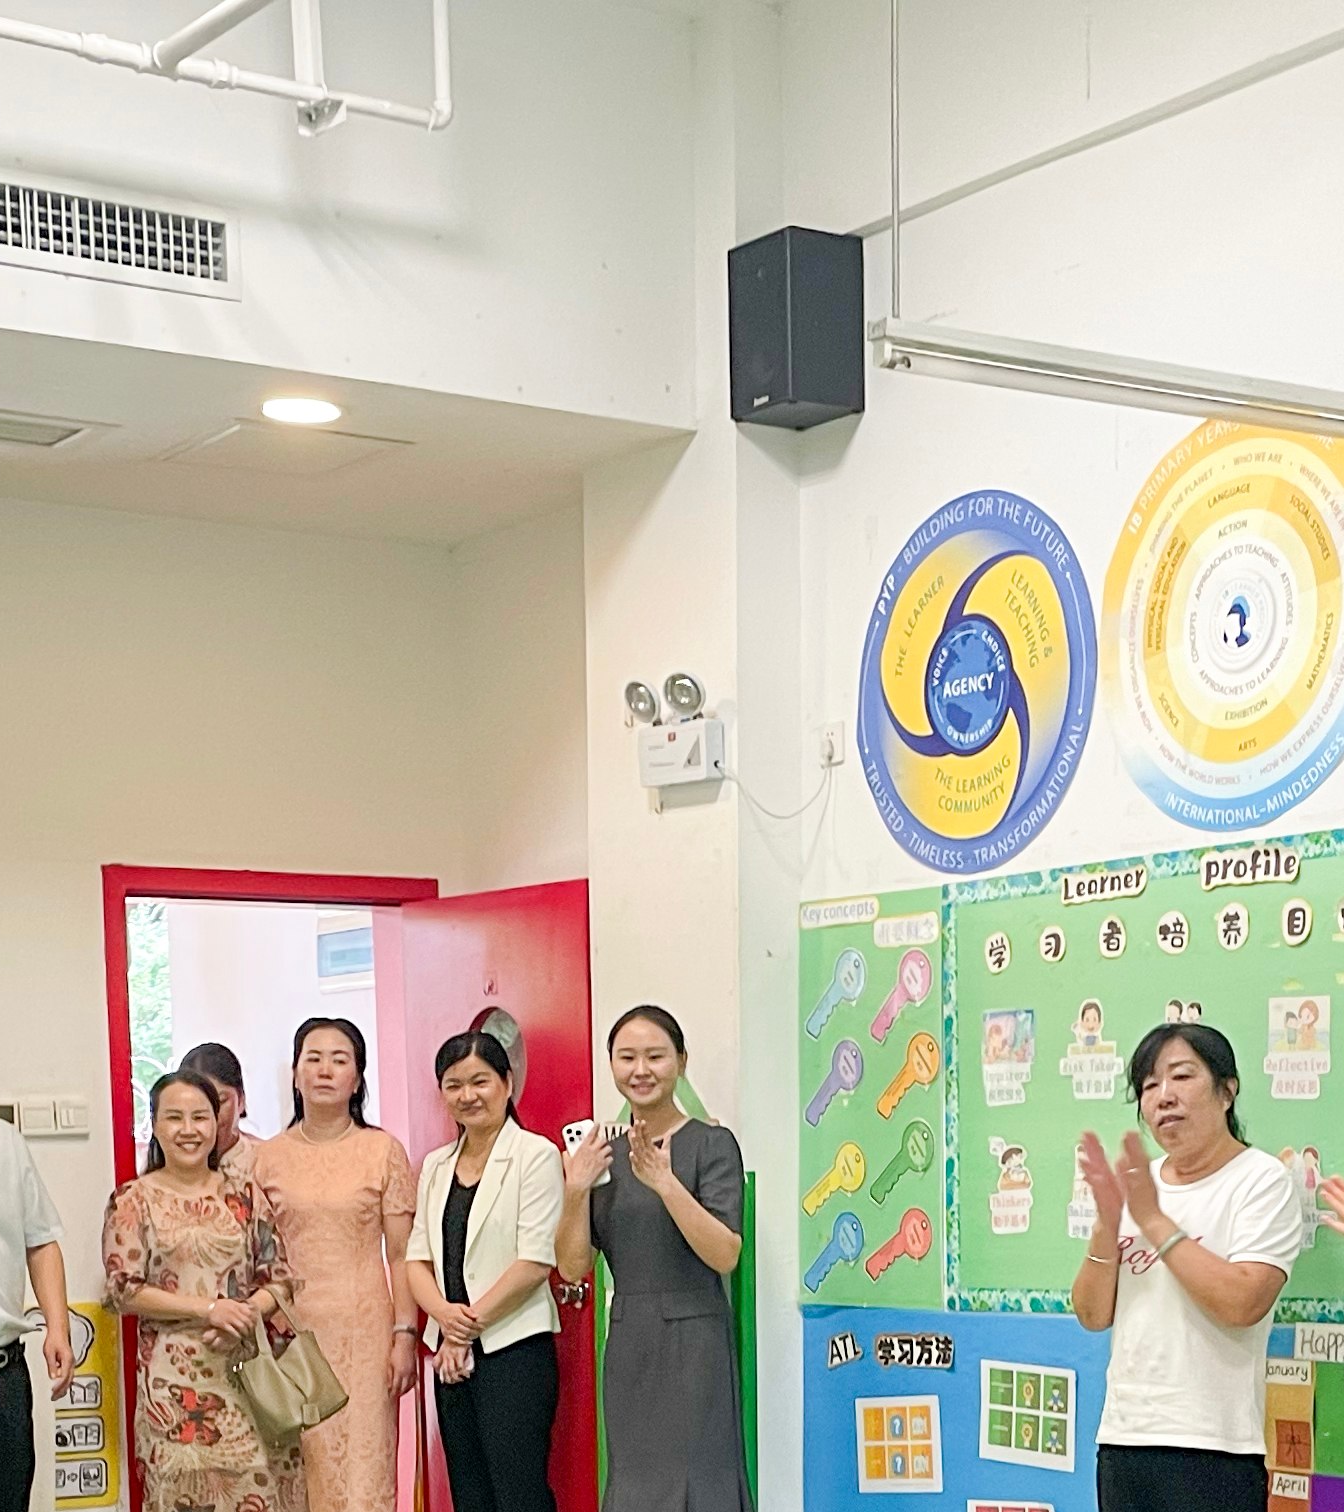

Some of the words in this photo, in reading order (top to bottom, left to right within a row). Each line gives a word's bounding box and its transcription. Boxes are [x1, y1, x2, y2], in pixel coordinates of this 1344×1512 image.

[1140, 446, 1194, 510] PRIMARY
[1184, 468, 1213, 496] PLANET
[1208, 482, 1251, 508] LANGUAGE
[1217, 519, 1248, 540] ACTION
[877, 574, 896, 616] PYP
[903, 502, 964, 565] BUILDING
[968, 497, 993, 517] FOR
[998, 497, 1022, 524] THE
[1023, 512, 1071, 573] FUTURE
[1234, 545, 1243, 555] TO
[1245, 544, 1279, 568] TEACHING
[1011, 569, 1050, 641] LEARNING
[895, 648, 908, 677] THE
[904, 575, 945, 638] LEARNER
[1005, 589, 1039, 668] TEACHING
[932, 646, 949, 686] VOICE
[981, 629, 1005, 672] CHOICE
[1245, 680, 1256, 692] TO
[1257, 637, 1289, 685] LEARNING
[1306, 612, 1334, 690] MATHEMATICS
[942, 672, 994, 699] AGENCY
[1224, 698, 1268, 721] EXHIBITION
[946, 717, 993, 744] OWNERSHIP
[1238, 737, 1257, 752] ARTS
[934, 768, 954, 791] THE
[955, 754, 1011, 794] LEARNING
[866, 760, 904, 833] TRUSTED
[908, 831, 965, 869] TIMELESS
[973, 722, 1084, 866] TRANSFORMATIONAL
[938, 783, 1006, 814] COMMUNITY
[1063, 867, 1145, 901] Learner
[1204, 848, 1297, 886] profile
[803, 905, 821, 924] Key
[823, 901, 875, 920] concepts
[829, 1333, 860, 1364] ATL
[878, 1336, 952, 1366] 学习方法
[1275, 1476, 1306, 1493] April
